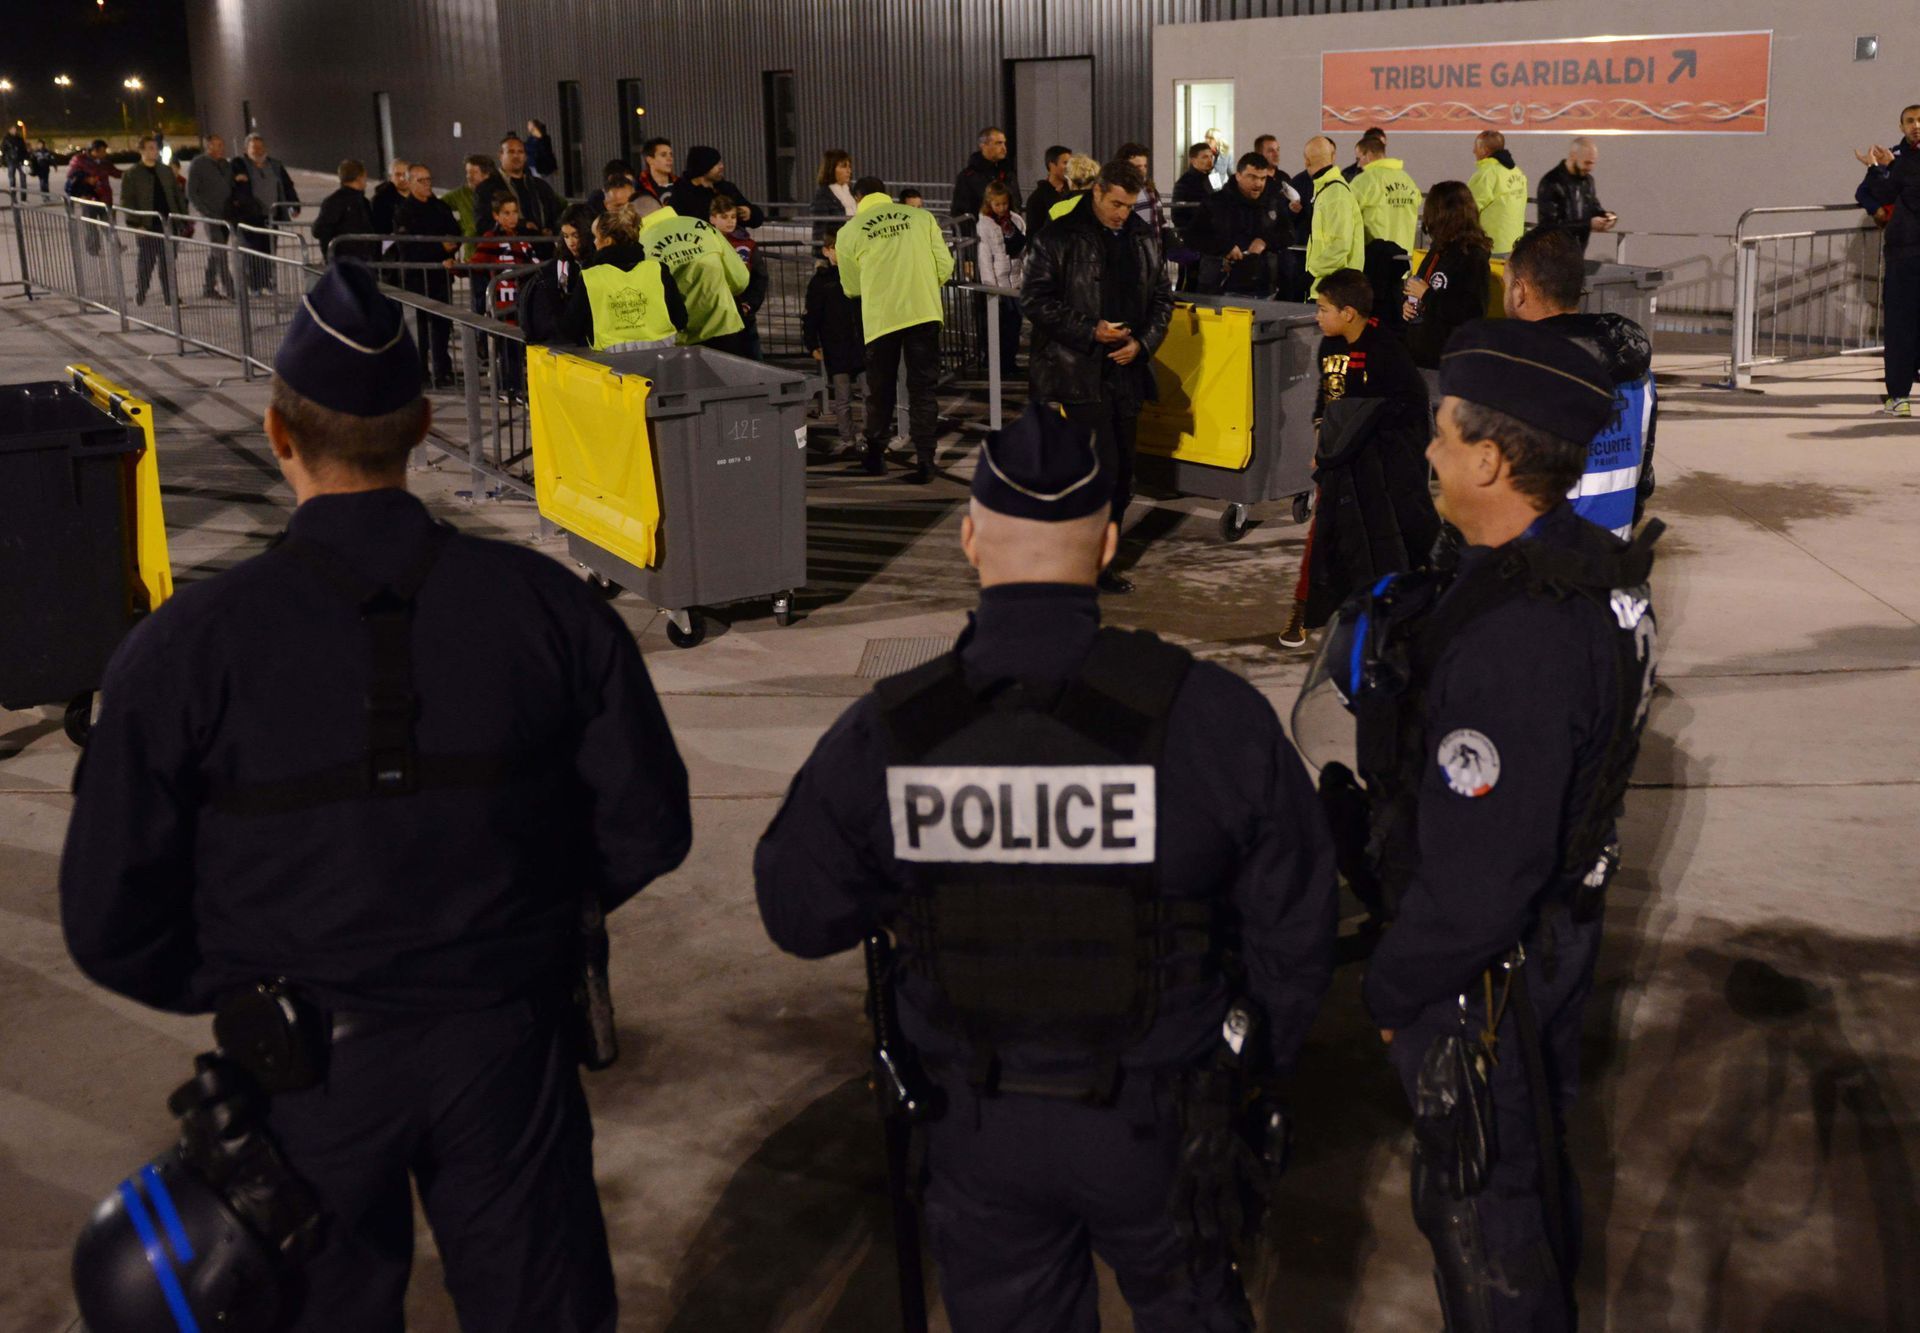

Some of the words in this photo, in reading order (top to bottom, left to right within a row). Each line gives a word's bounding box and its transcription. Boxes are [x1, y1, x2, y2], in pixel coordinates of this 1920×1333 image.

[1370, 62, 1483, 90] TRIBUNE
[1490, 56, 1656, 88] GARIBALDI
[862, 212, 911, 231] IMPACT
[651, 232, 703, 258] IMPACT
[728, 418, 760, 440] 12E
[904, 783, 1137, 849] POLICE
